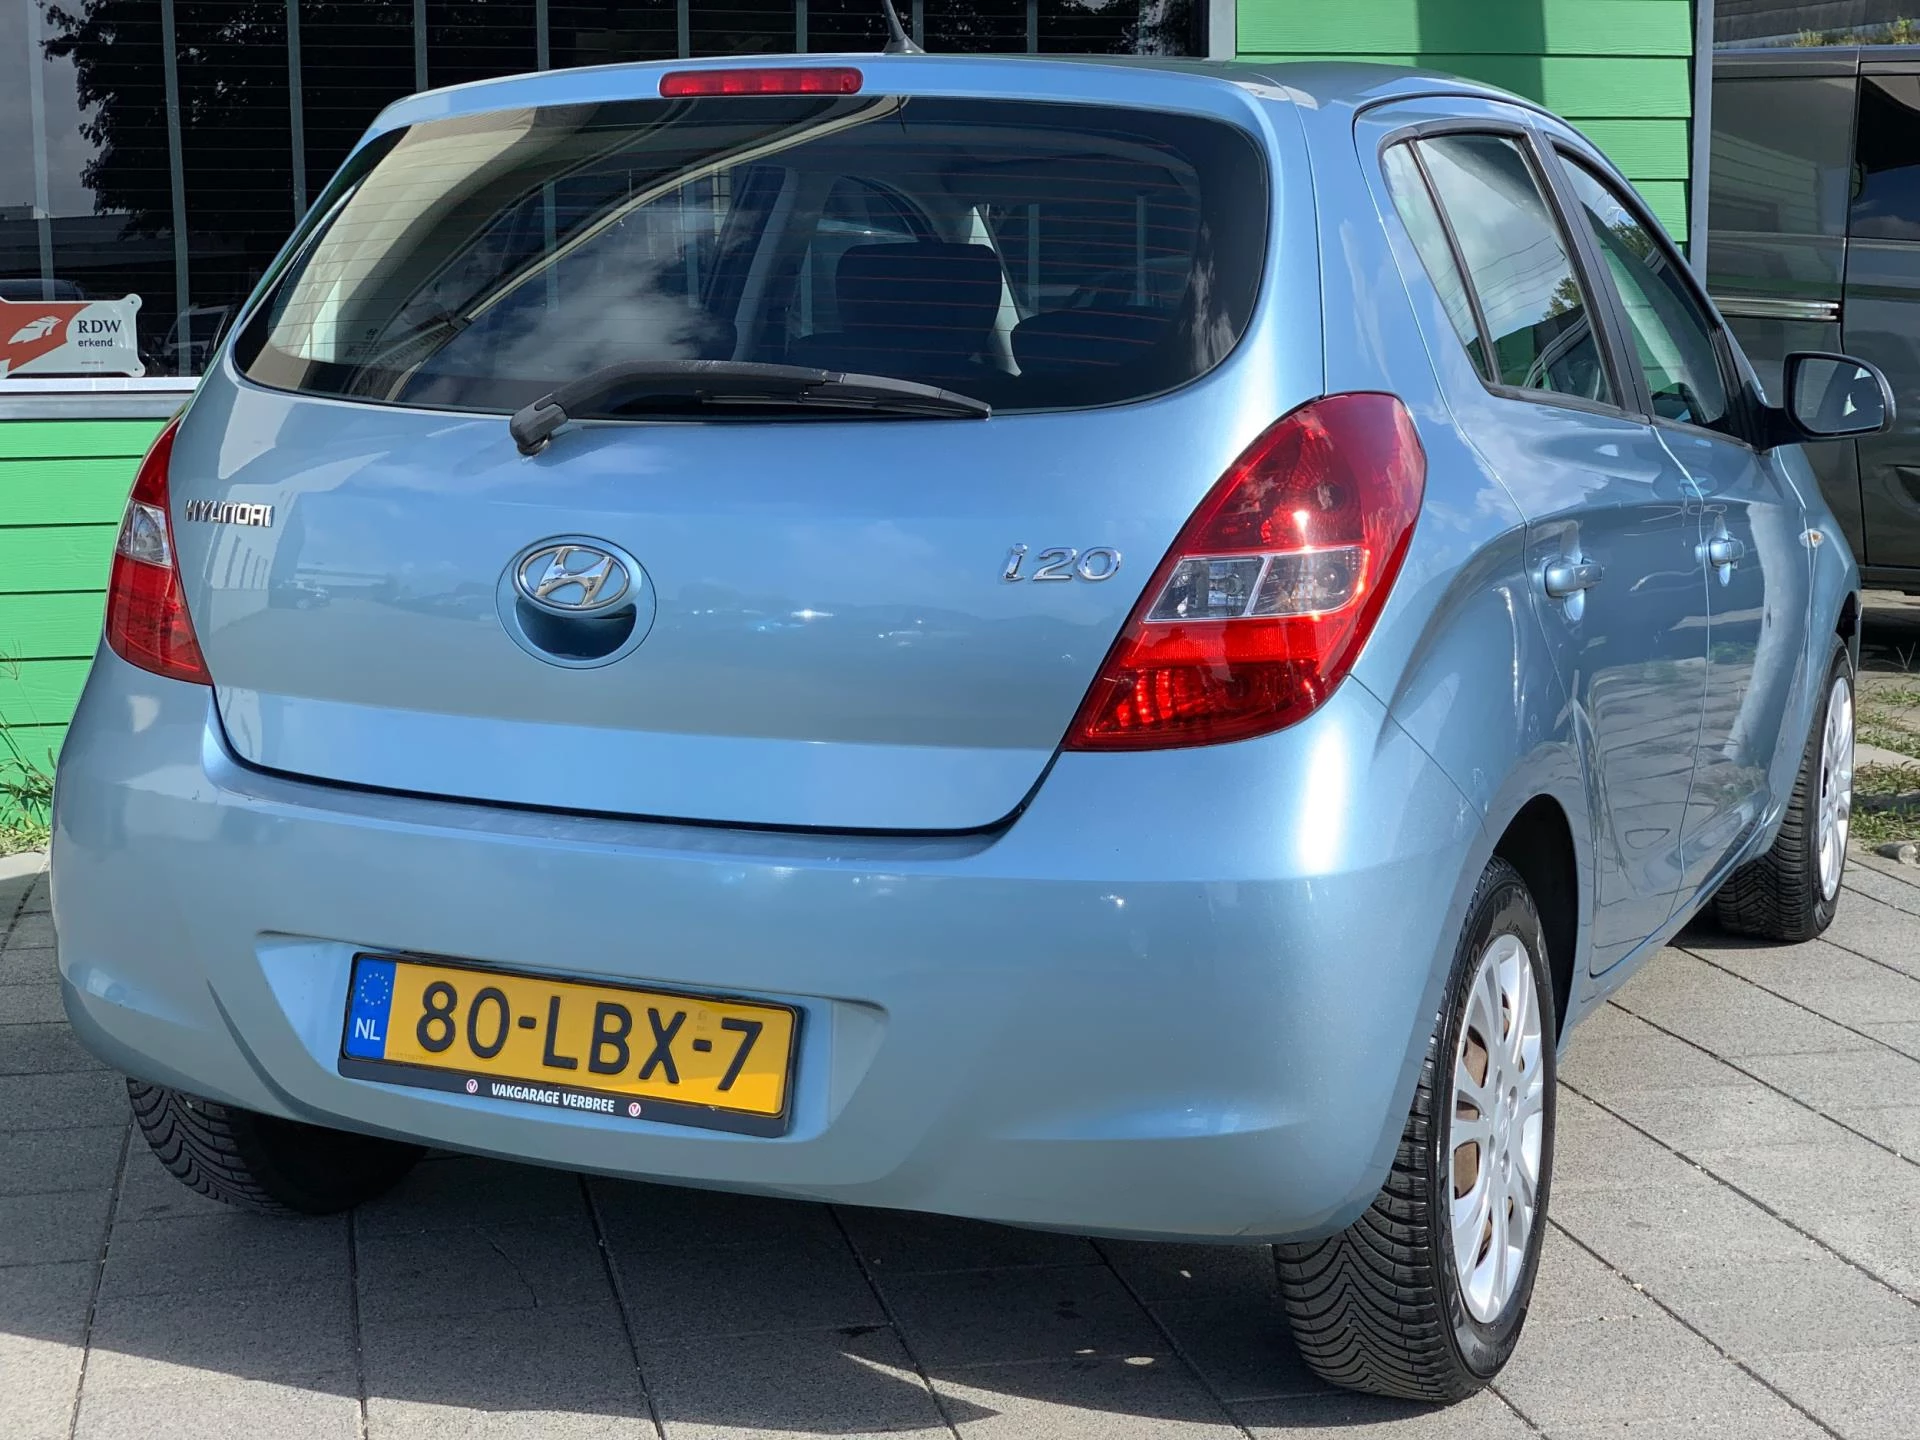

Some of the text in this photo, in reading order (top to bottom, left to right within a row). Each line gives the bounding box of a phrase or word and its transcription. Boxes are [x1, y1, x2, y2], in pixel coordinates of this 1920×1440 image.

[78, 320, 122, 333] RDW
[78, 338, 113, 347] erkend
[186, 499, 273, 528] HYUNDAI
[1003, 543, 1122, 582] i20
[354, 1016, 381, 1041] NL
[415, 980, 764, 1092] 80-LBX-7
[491, 1083, 559, 1105] VAKGARAGE
[562, 1092, 615, 1113] VERBREE
